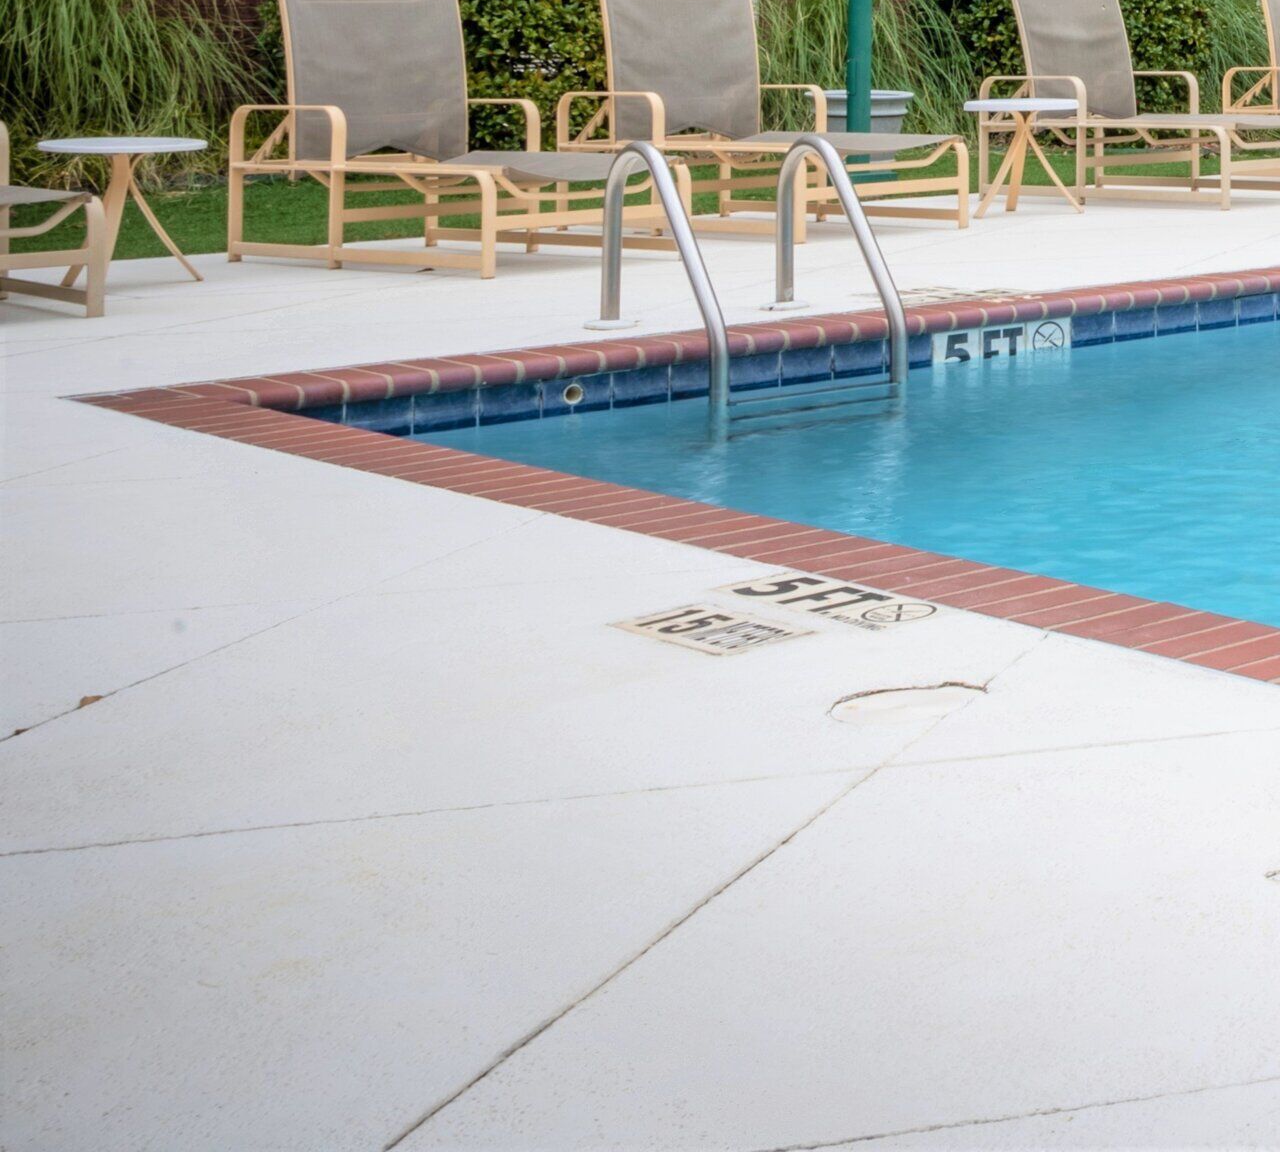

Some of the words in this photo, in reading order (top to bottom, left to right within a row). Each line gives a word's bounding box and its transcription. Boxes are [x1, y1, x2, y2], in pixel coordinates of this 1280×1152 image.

[944, 332, 971, 363] 5
[983, 326, 1023, 359] FT
[732, 576, 828, 596] 5
